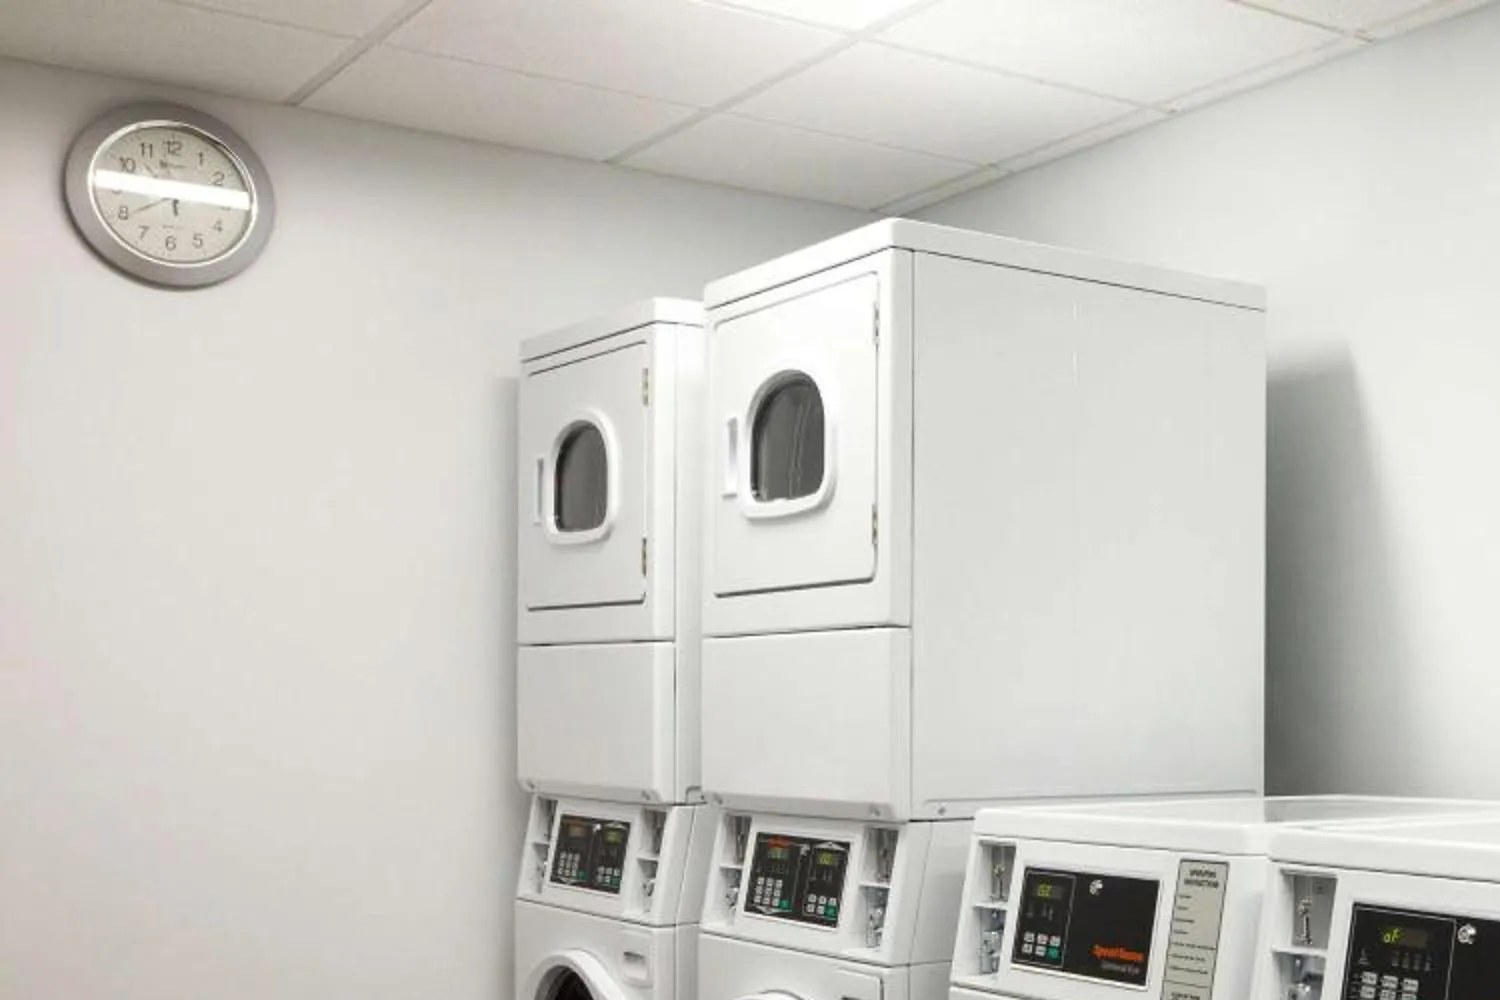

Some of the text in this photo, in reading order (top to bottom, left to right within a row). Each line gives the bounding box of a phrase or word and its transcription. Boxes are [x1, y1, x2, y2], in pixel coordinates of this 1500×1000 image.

[140, 142, 153, 159] 11
[164, 140, 182, 154] 12
[119, 157, 136, 173] 10
[198, 152, 203, 167] 1
[211, 171, 225, 187] 2
[118, 206, 129, 220] 8
[138, 226, 149, 240] 7
[213, 220, 223, 233] 4
[165, 235, 176, 250] 6
[192, 233, 203, 248] 5
